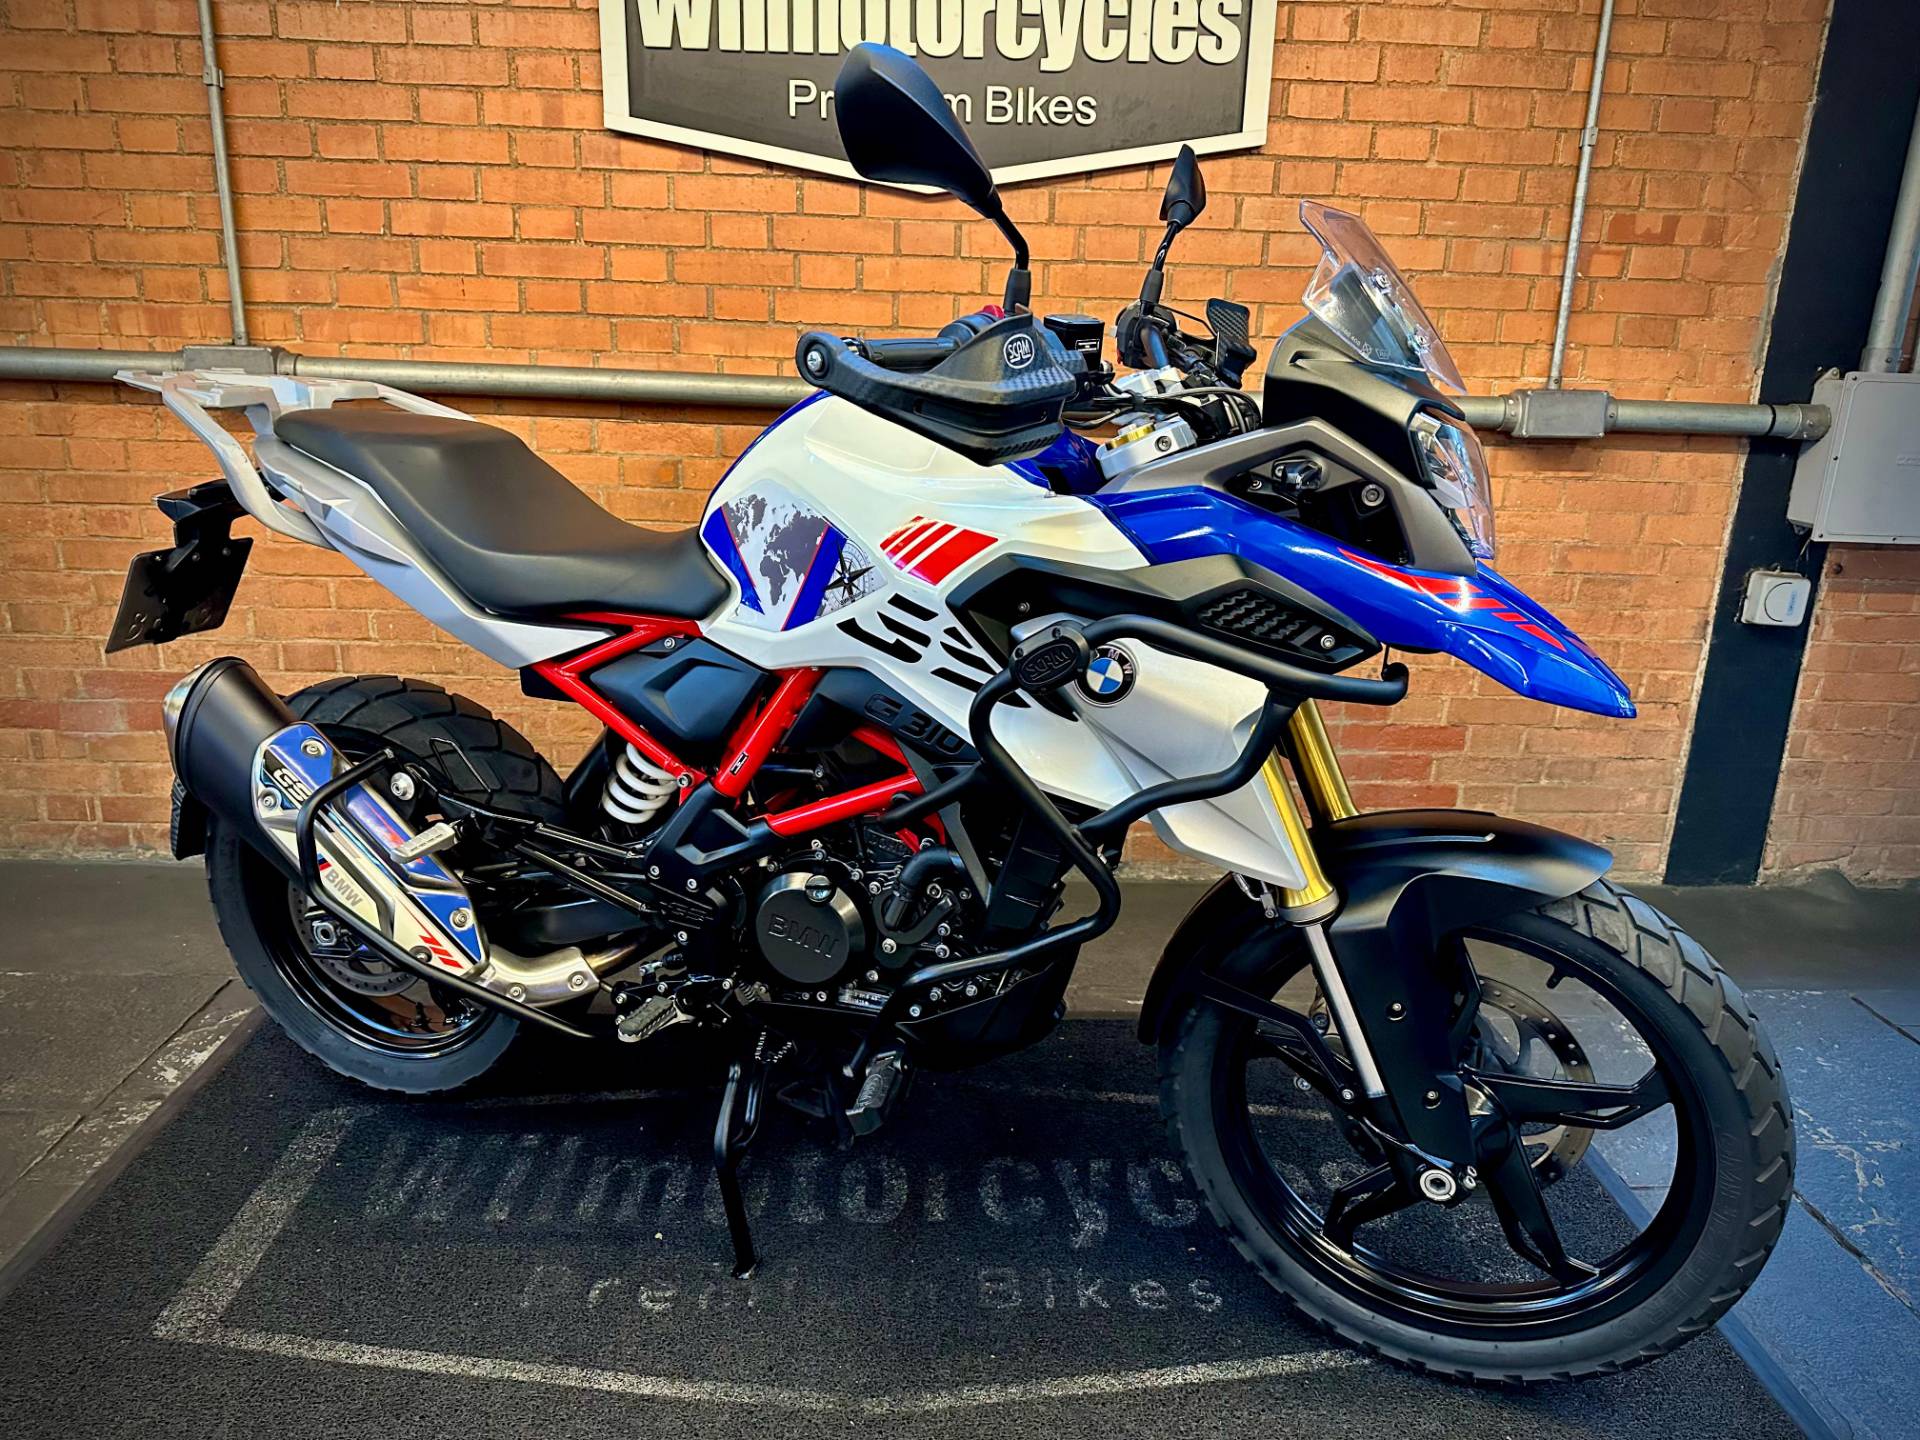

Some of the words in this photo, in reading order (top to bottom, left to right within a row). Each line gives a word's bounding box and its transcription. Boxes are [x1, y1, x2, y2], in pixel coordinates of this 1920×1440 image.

[863, 693, 904, 727] G
[898, 711, 968, 755] 310
[325, 868, 363, 907] BMW
[767, 912, 840, 958] BMW
[976, 1266, 1223, 1314] Bikes
